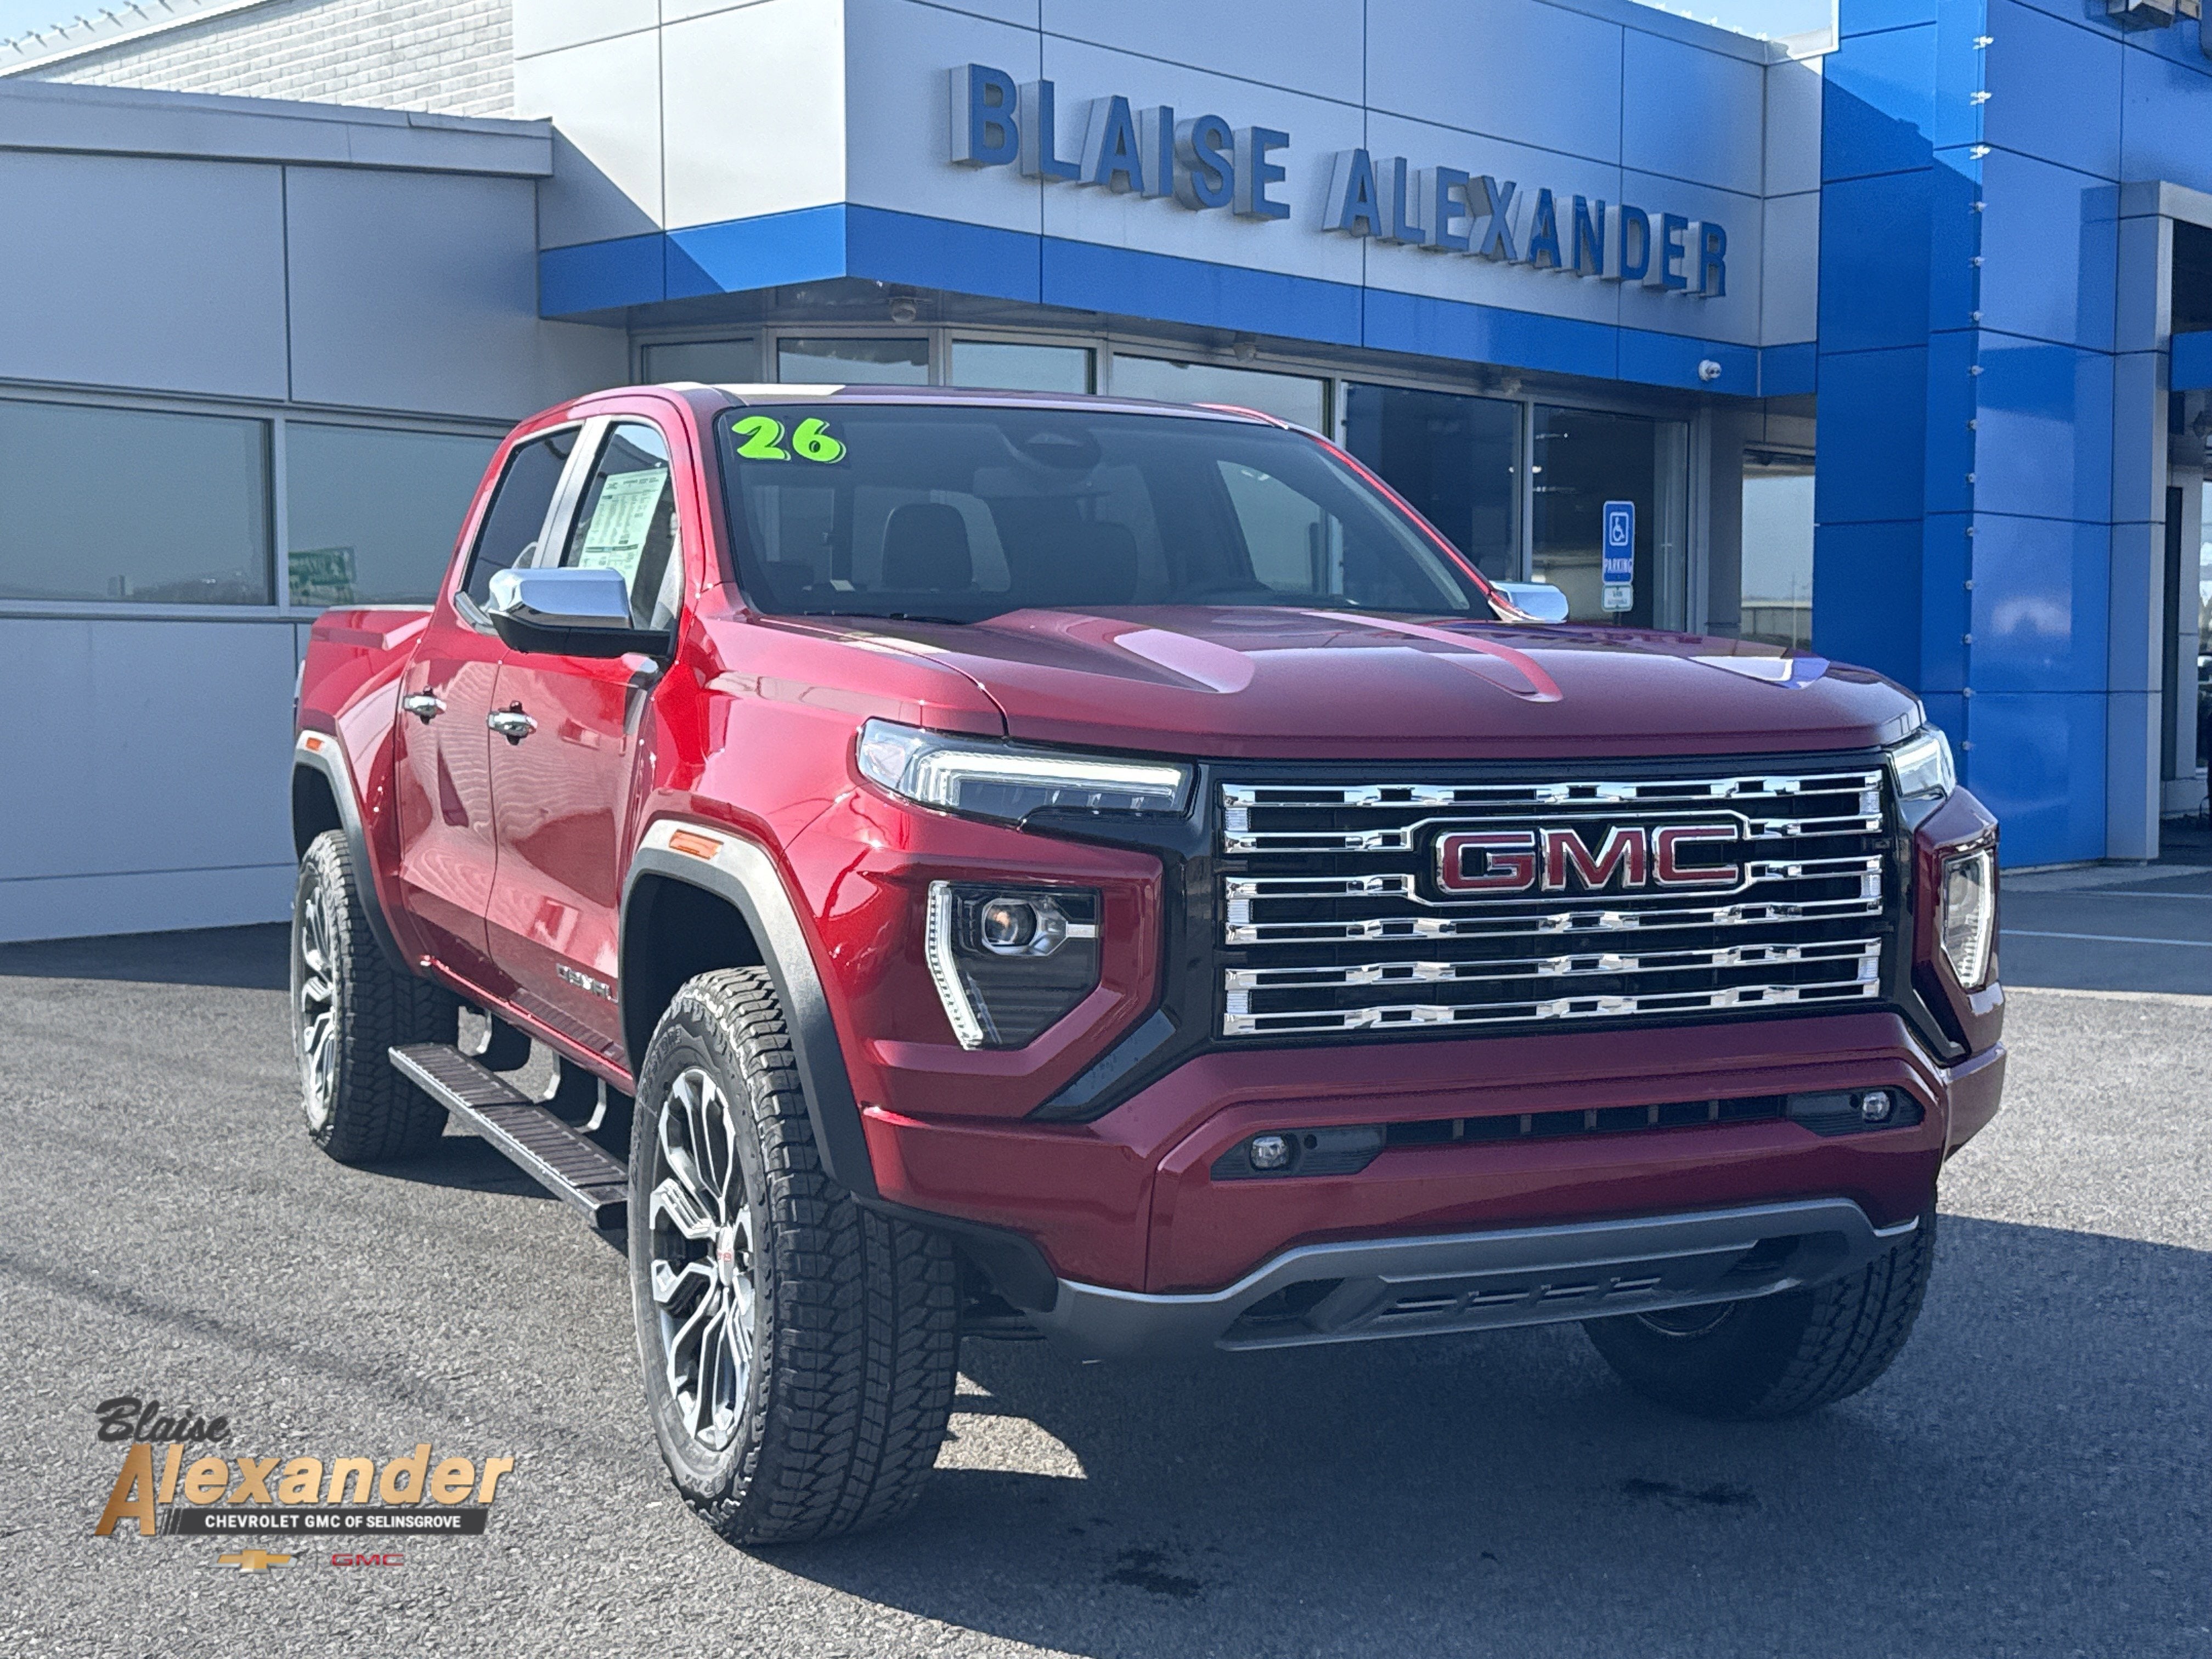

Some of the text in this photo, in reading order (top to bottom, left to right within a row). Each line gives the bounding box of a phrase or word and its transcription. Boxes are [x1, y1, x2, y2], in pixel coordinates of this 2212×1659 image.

[956, 63, 1727, 297] BLAISE ALEXANDER
[731, 415, 847, 464] 26
[1435, 824, 1739, 894] GMC
